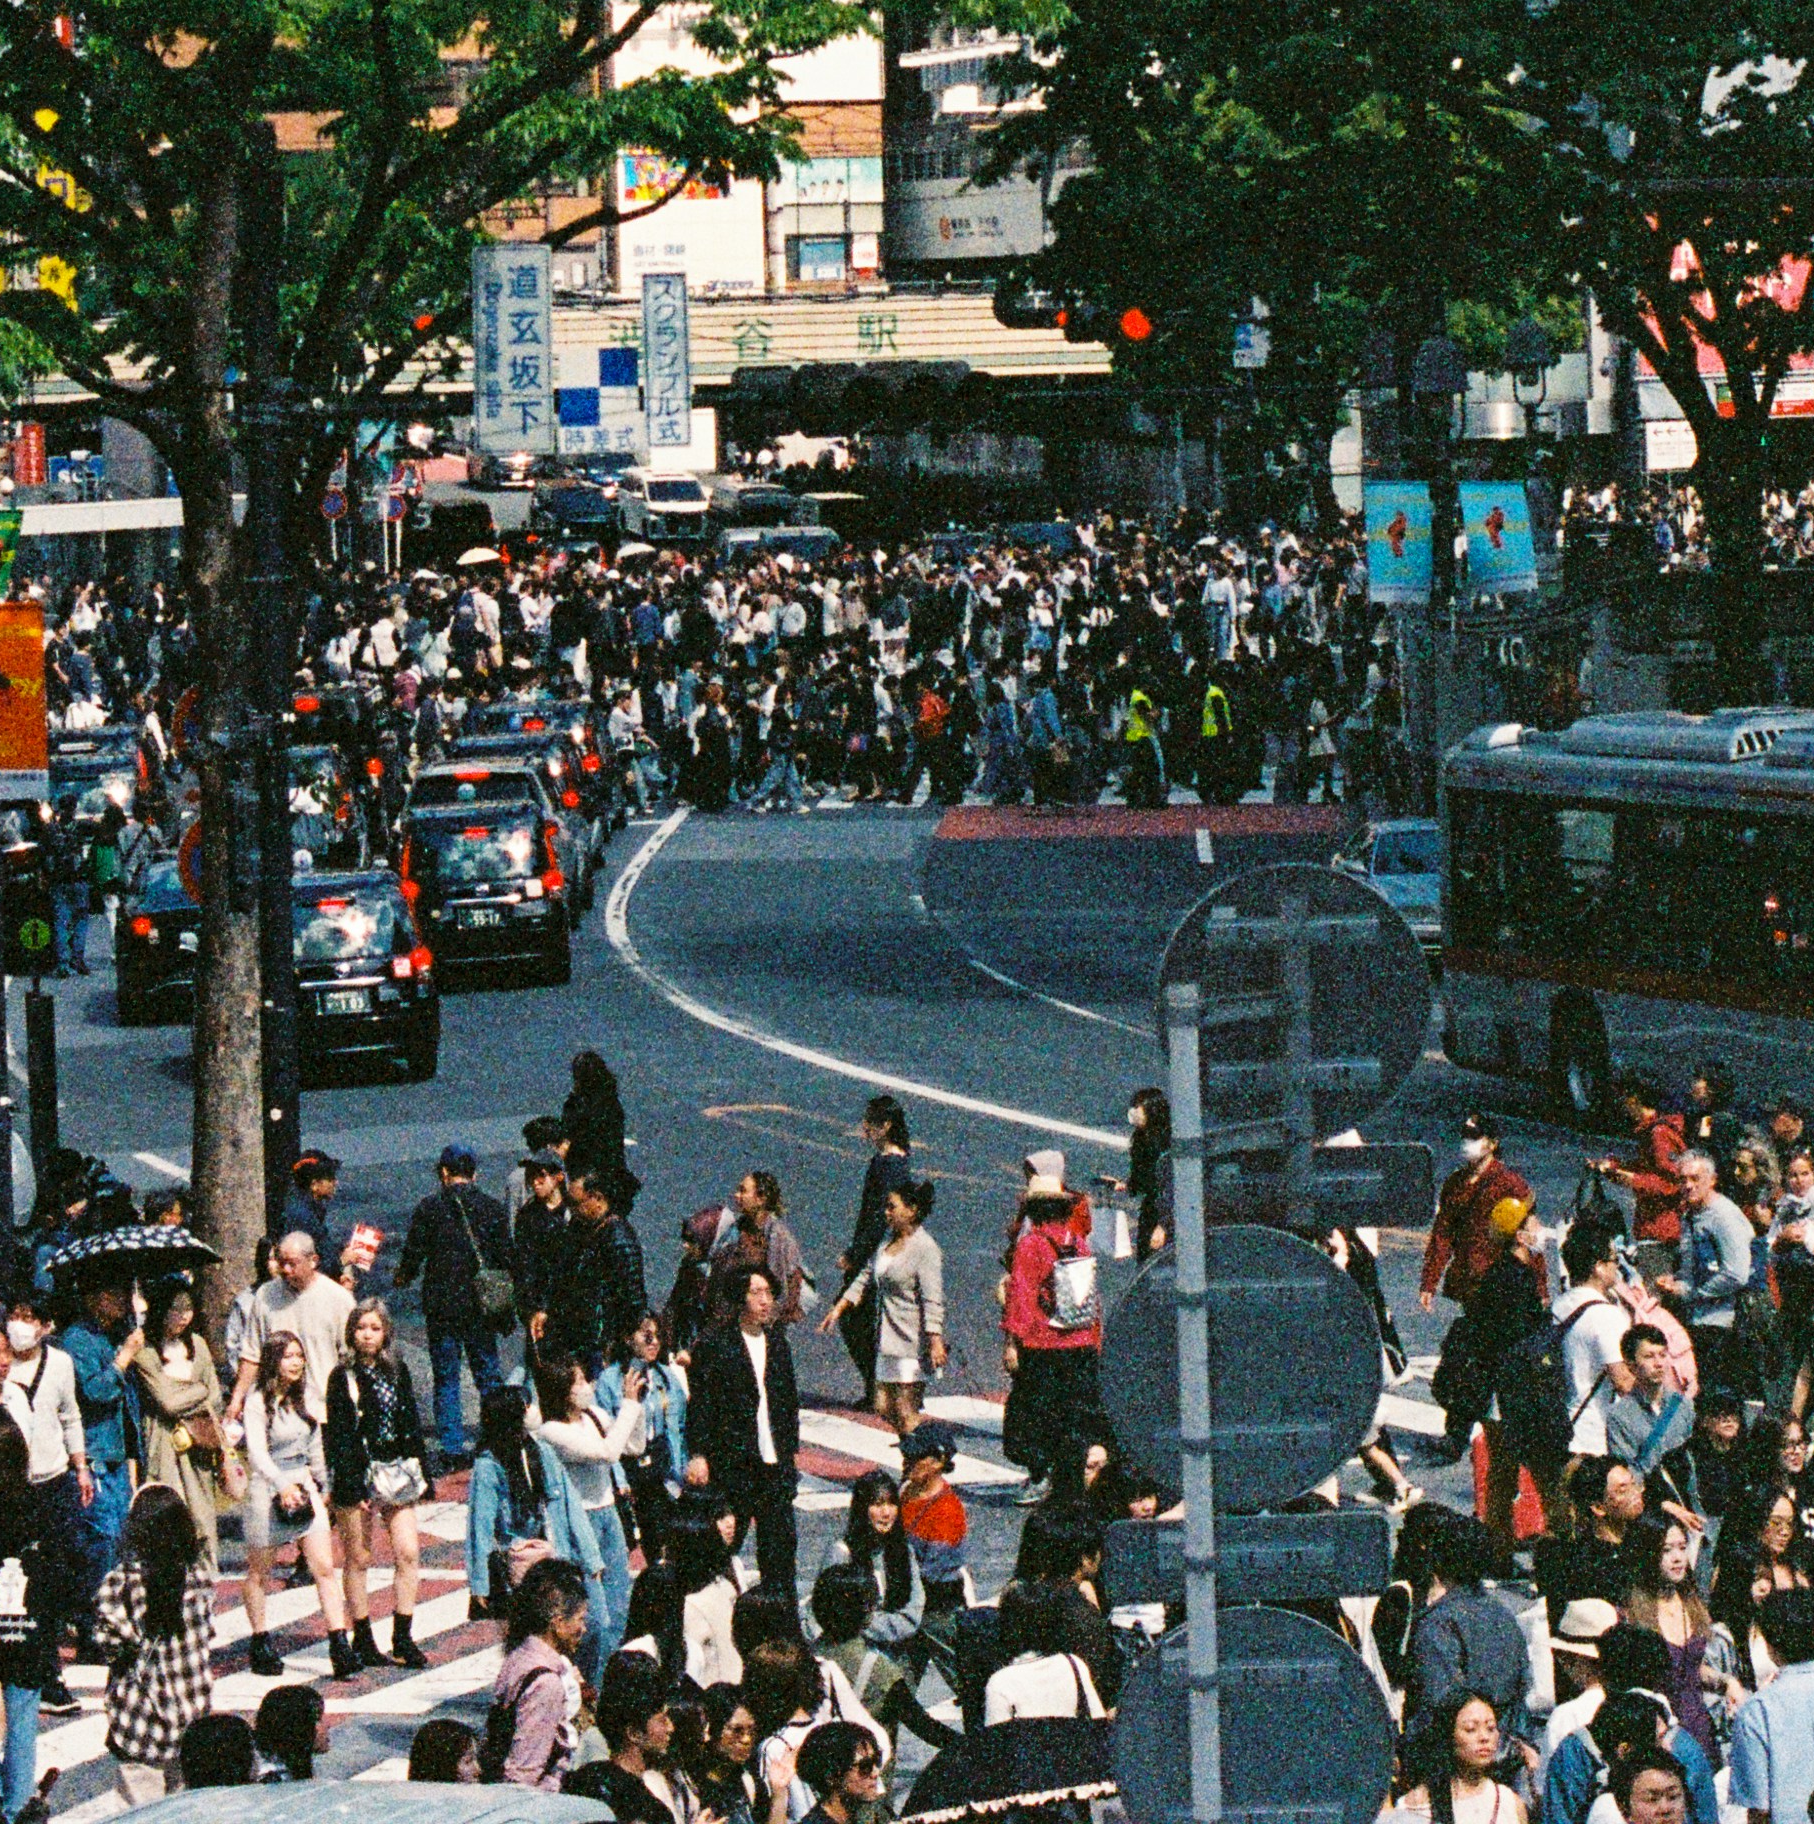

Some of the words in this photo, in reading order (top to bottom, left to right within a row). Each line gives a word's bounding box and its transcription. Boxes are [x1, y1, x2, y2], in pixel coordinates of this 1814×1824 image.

[507, 263, 542, 436] 道玄坂下
[652, 278, 682, 441] スクランブル式
[564, 426, 636, 451] 時差式
